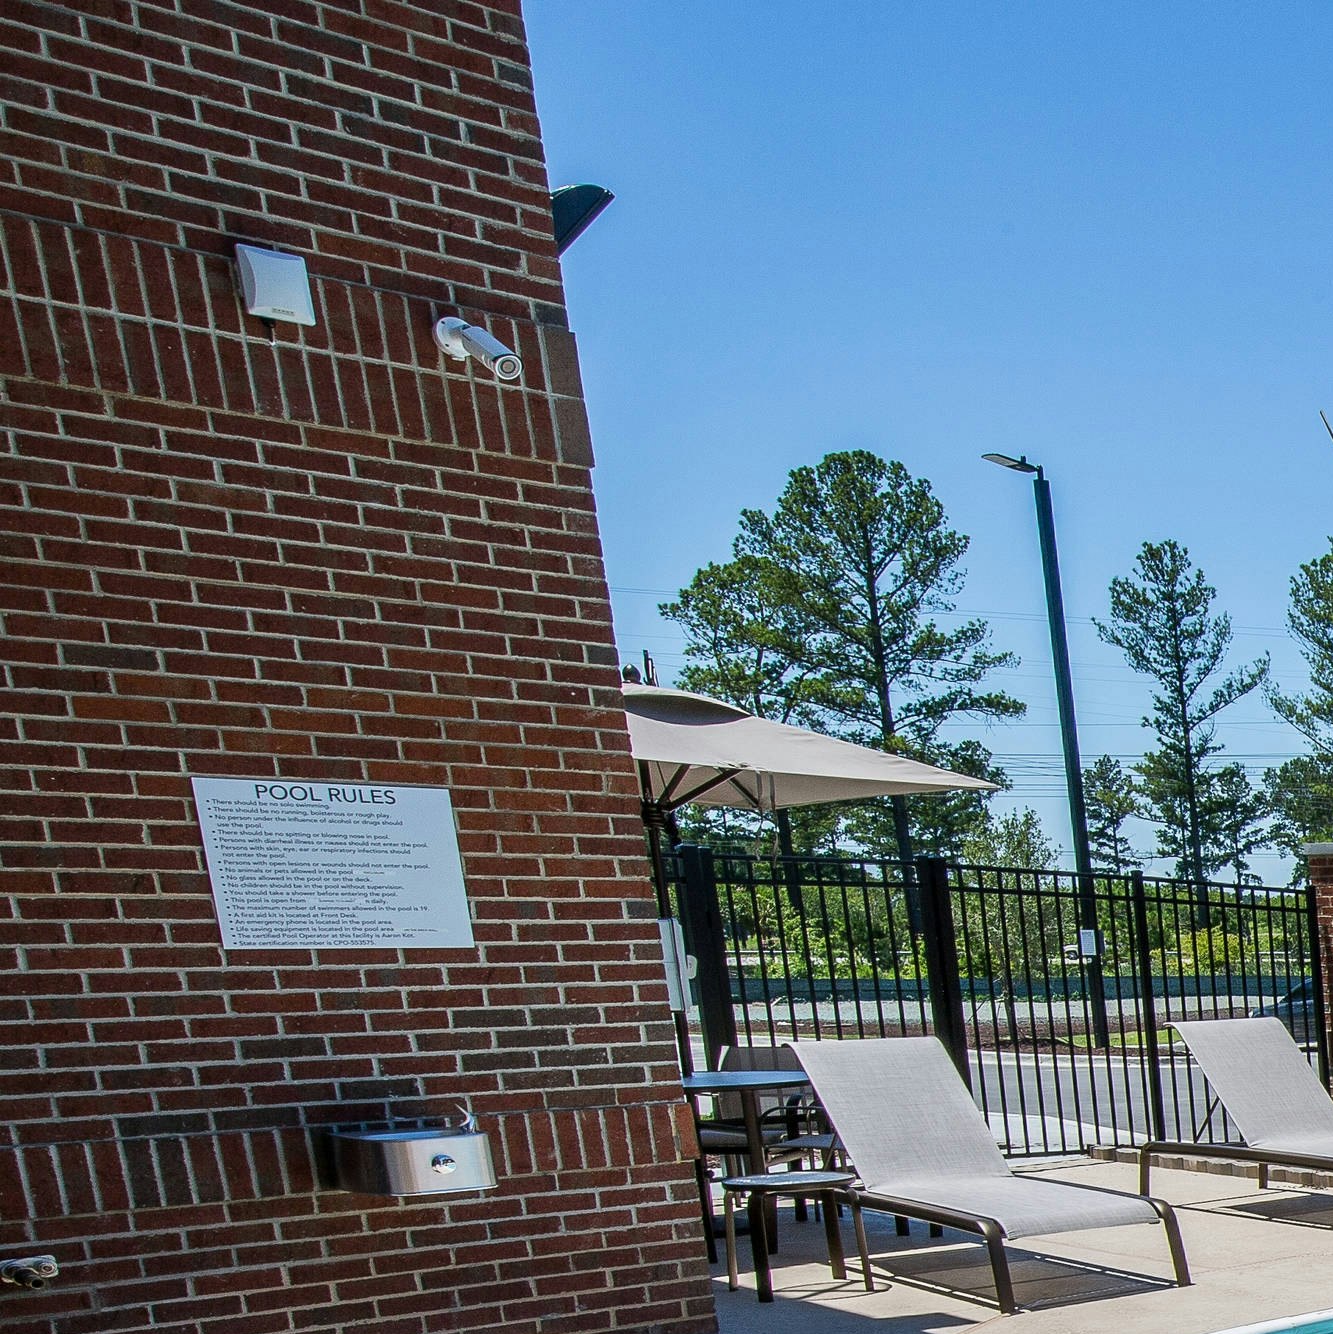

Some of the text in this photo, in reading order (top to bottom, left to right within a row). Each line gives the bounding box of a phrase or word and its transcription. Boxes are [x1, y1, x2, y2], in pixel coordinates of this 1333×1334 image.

[254, 784, 396, 805] POOL RULES
[354, 811, 375, 819] rough
[284, 830, 311, 838] spitting
[318, 846, 356, 854] respiratory
